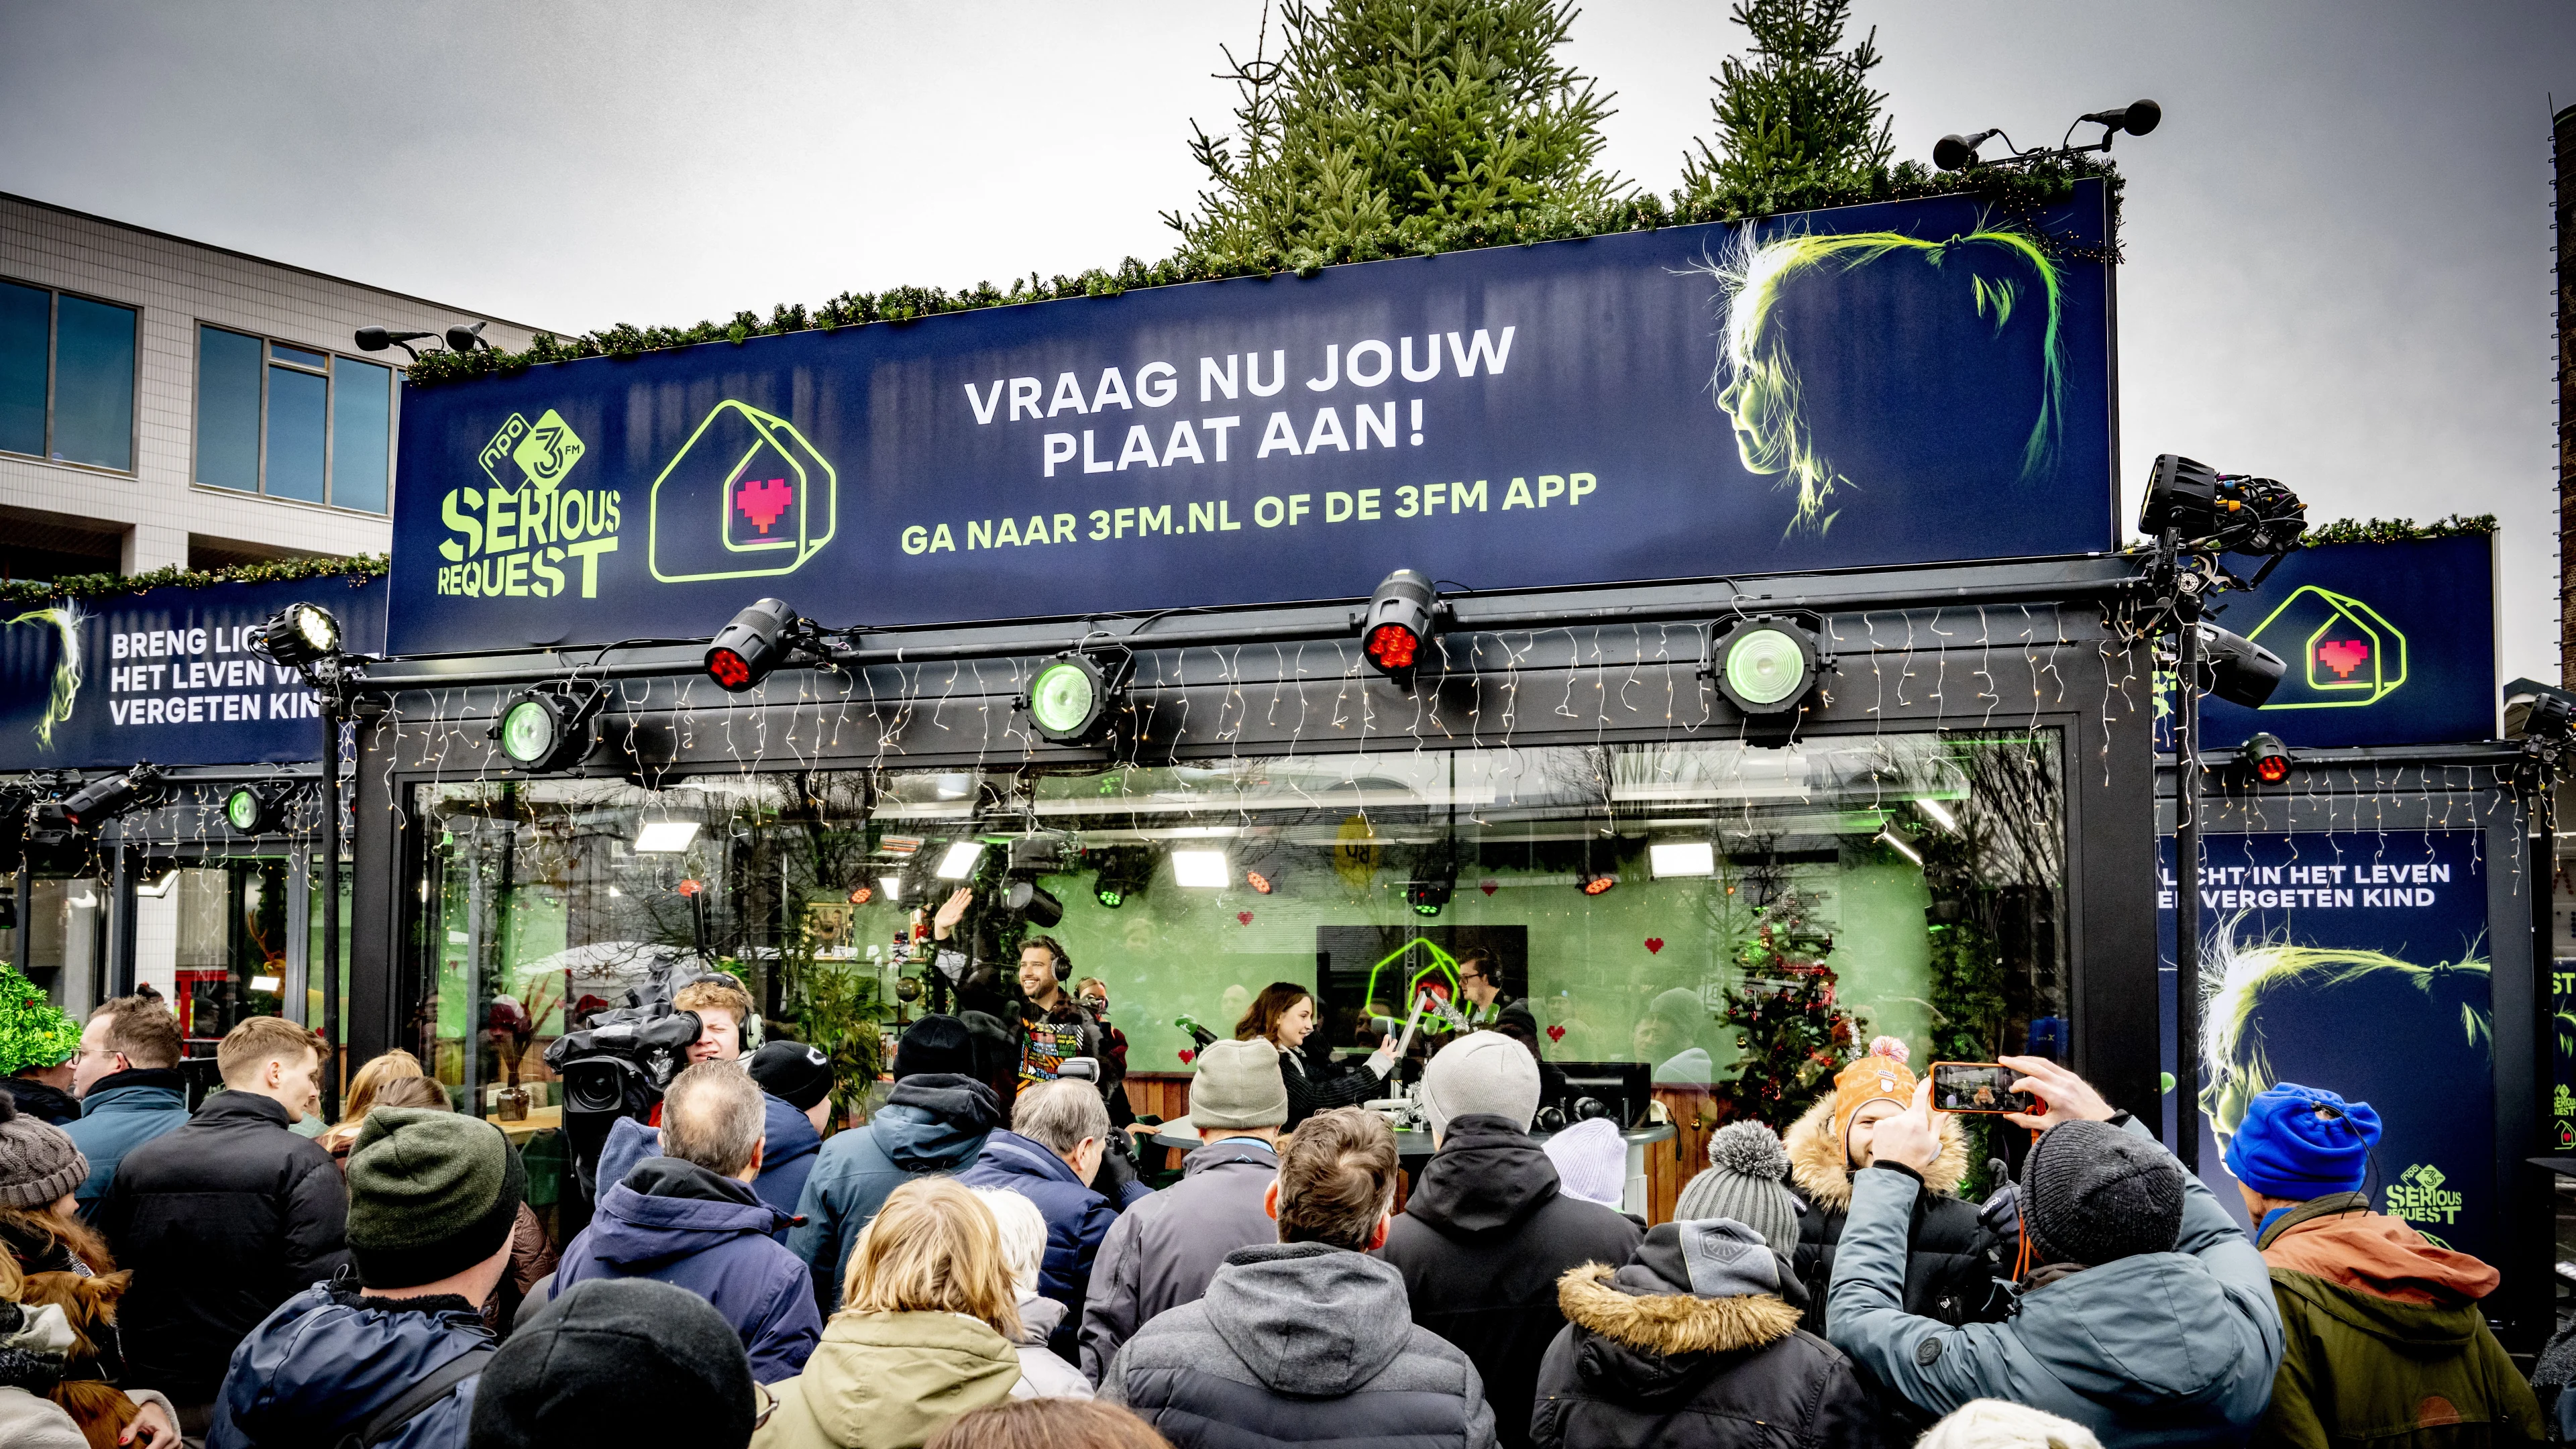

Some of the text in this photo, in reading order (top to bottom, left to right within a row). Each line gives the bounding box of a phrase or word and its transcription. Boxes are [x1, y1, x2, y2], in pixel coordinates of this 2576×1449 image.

[964, 326, 1516, 425] VRAAG NU JOUW
[484, 419, 523, 468] npo
[1044, 398, 1424, 478] PLAAT AAN!
[438, 487, 621, 561] SERIOUS
[902, 472, 1597, 554] GA NAAR 3FM.NL OF DE 3FM APP
[437, 536, 619, 598] REQUEST
[112, 625, 261, 659] BRENG LIC
[111, 664, 166, 692] HET
[172, 659, 265, 689] LEVEN
[272, 658, 322, 685] VA
[109, 691, 320, 725] VERGETEN KIN
[2253, 866, 2279, 885] IN
[2290, 865, 2347, 885] HET
[2355, 865, 2450, 884] LEVEN
[2200, 889, 2353, 908] VERGETEN
[2363, 888, 2434, 908] KIND
[1980, 1196, 2002, 1216] reusch
[2386, 1184, 2462, 1208] SERIOUS
